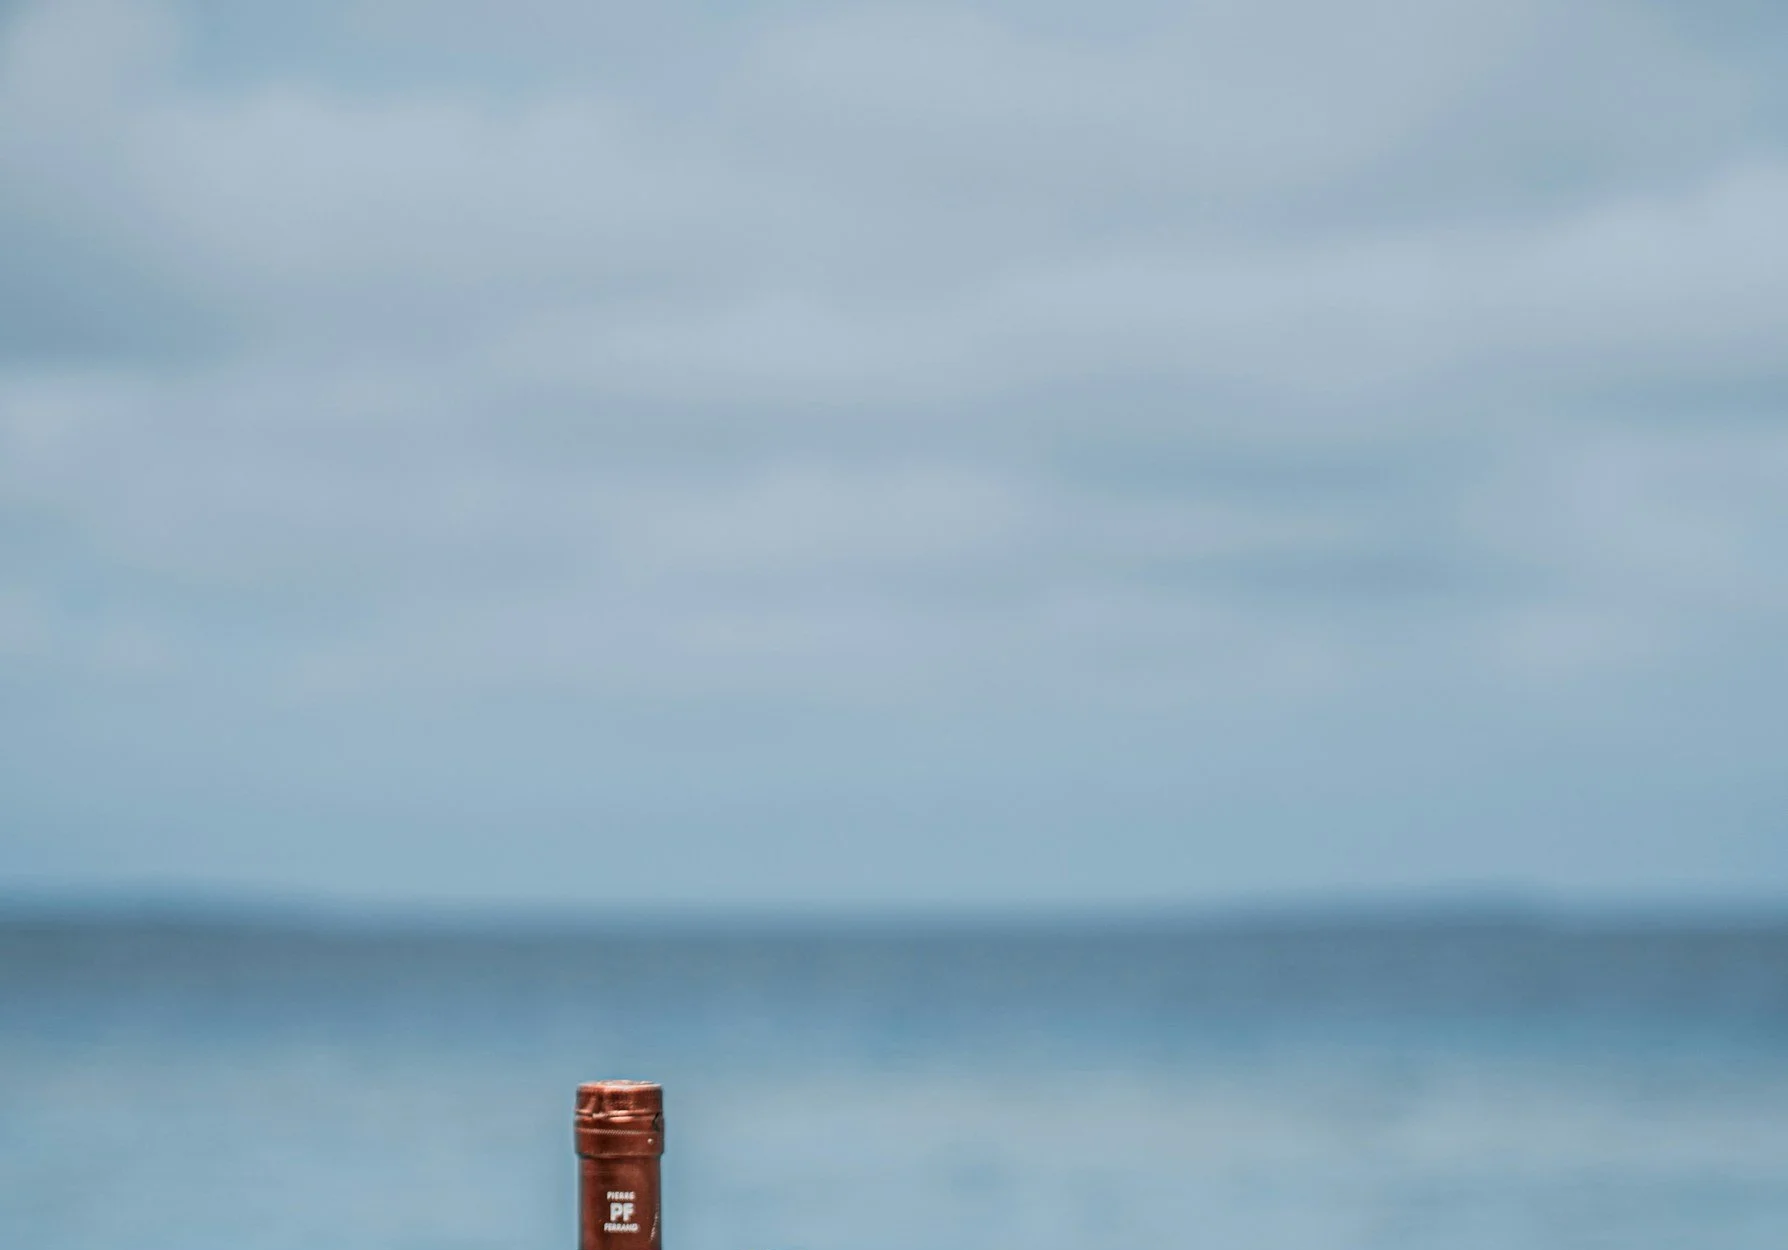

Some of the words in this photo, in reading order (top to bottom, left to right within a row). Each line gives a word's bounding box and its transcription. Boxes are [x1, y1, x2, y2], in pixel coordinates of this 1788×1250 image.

[607, 1191, 636, 1201] PIERRE
[610, 1202, 635, 1222] PF
[604, 1223, 639, 1233] FERRAND
